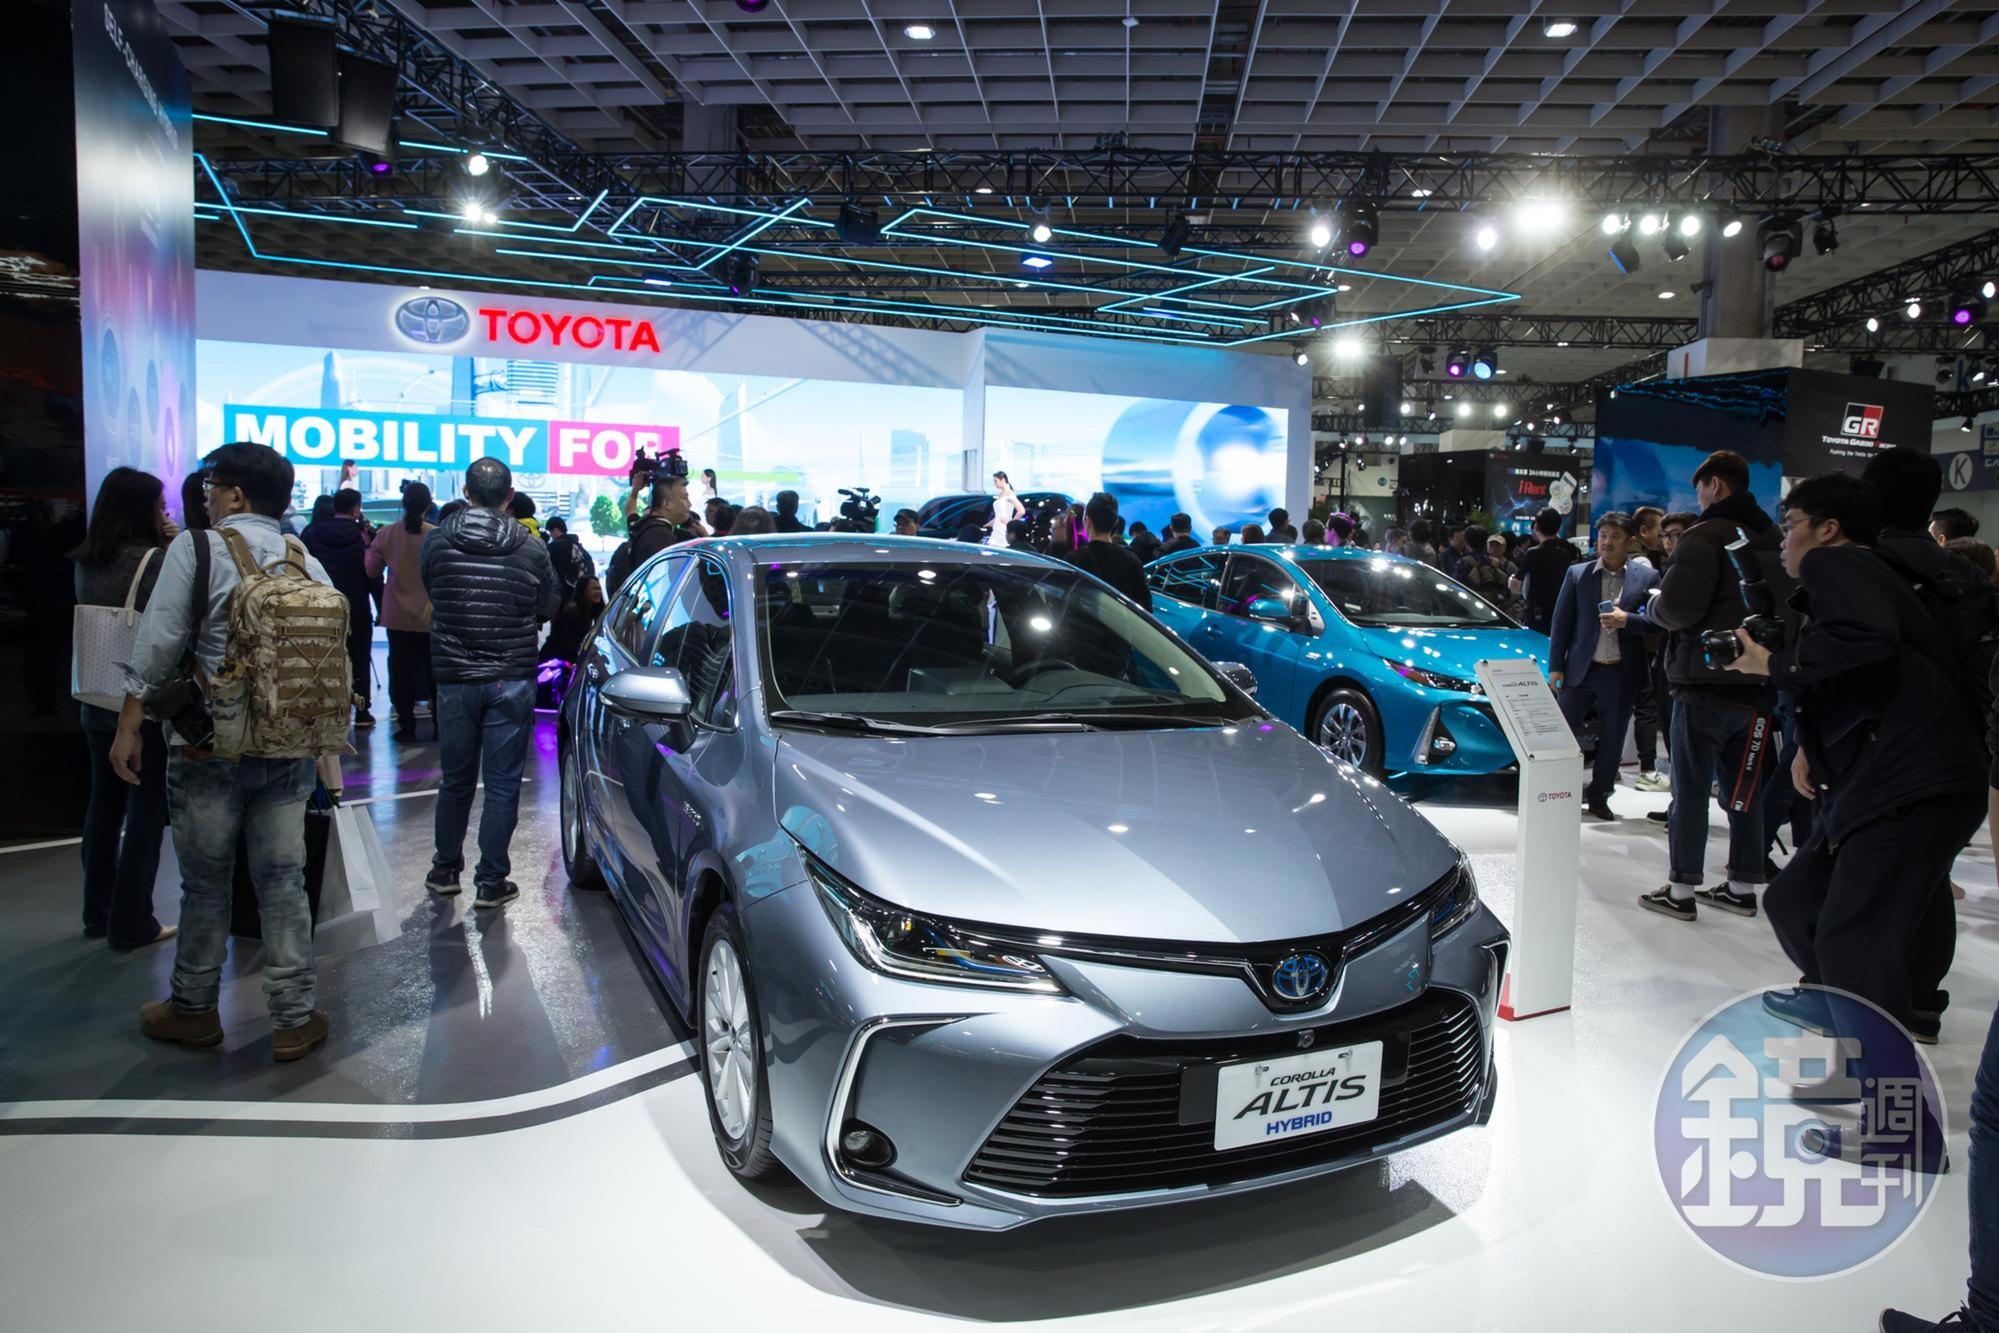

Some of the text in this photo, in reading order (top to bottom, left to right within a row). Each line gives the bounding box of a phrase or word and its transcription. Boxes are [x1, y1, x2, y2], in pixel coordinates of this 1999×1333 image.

[479, 308, 661, 353] TOYOTA
[1843, 416, 1879, 436] GR
[235, 413, 538, 467] MOBILITY
[1822, 435, 1849, 445] TOYOTA
[1953, 457, 1968, 485] K
[1753, 717, 1766, 739] EOS
[1750, 739, 1761, 751] 7D
[1548, 792, 1572, 800] TOYOTA
[1270, 1067, 1336, 1087] COROLLA
[1233, 1074, 1367, 1120] ALTIS
[1266, 1111, 1332, 1135] HYBRID
